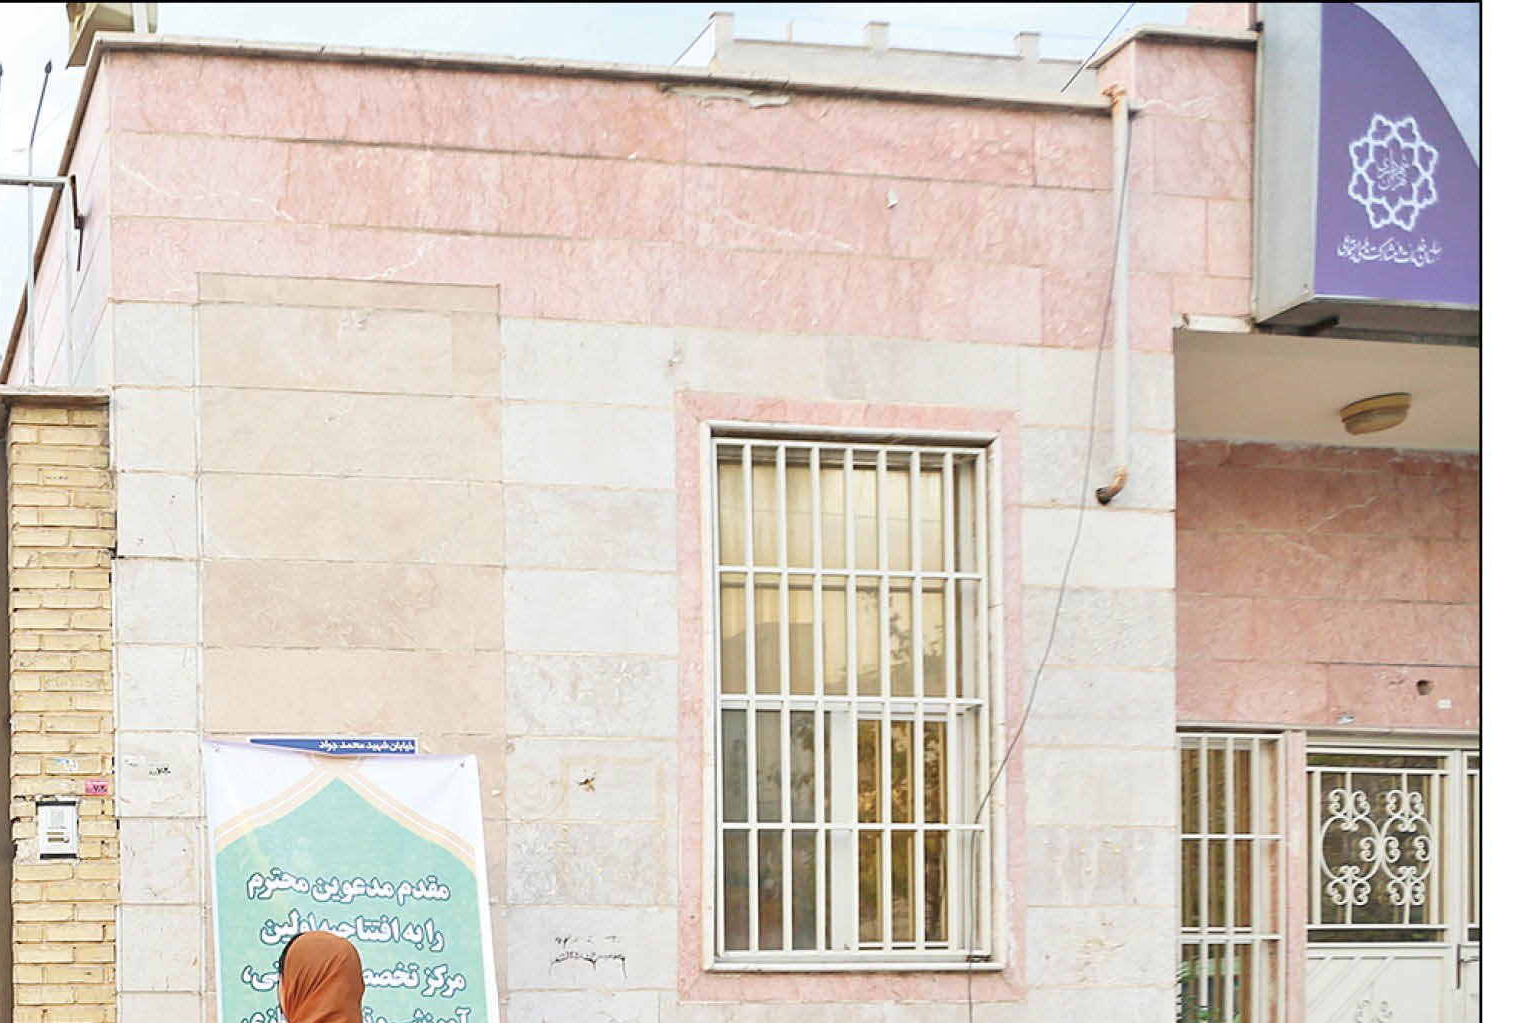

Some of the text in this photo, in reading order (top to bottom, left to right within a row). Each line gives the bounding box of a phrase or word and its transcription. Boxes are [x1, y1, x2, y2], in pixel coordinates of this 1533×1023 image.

[340, 741, 365, 750] محمد
[366, 740, 389, 752] شهید
[246, 867, 450, 906] مقدم مدعوین محترم
[402, 921, 425, 950] به
[422, 917, 445, 952] را
[363, 962, 467, 998] مرکز تخصص
